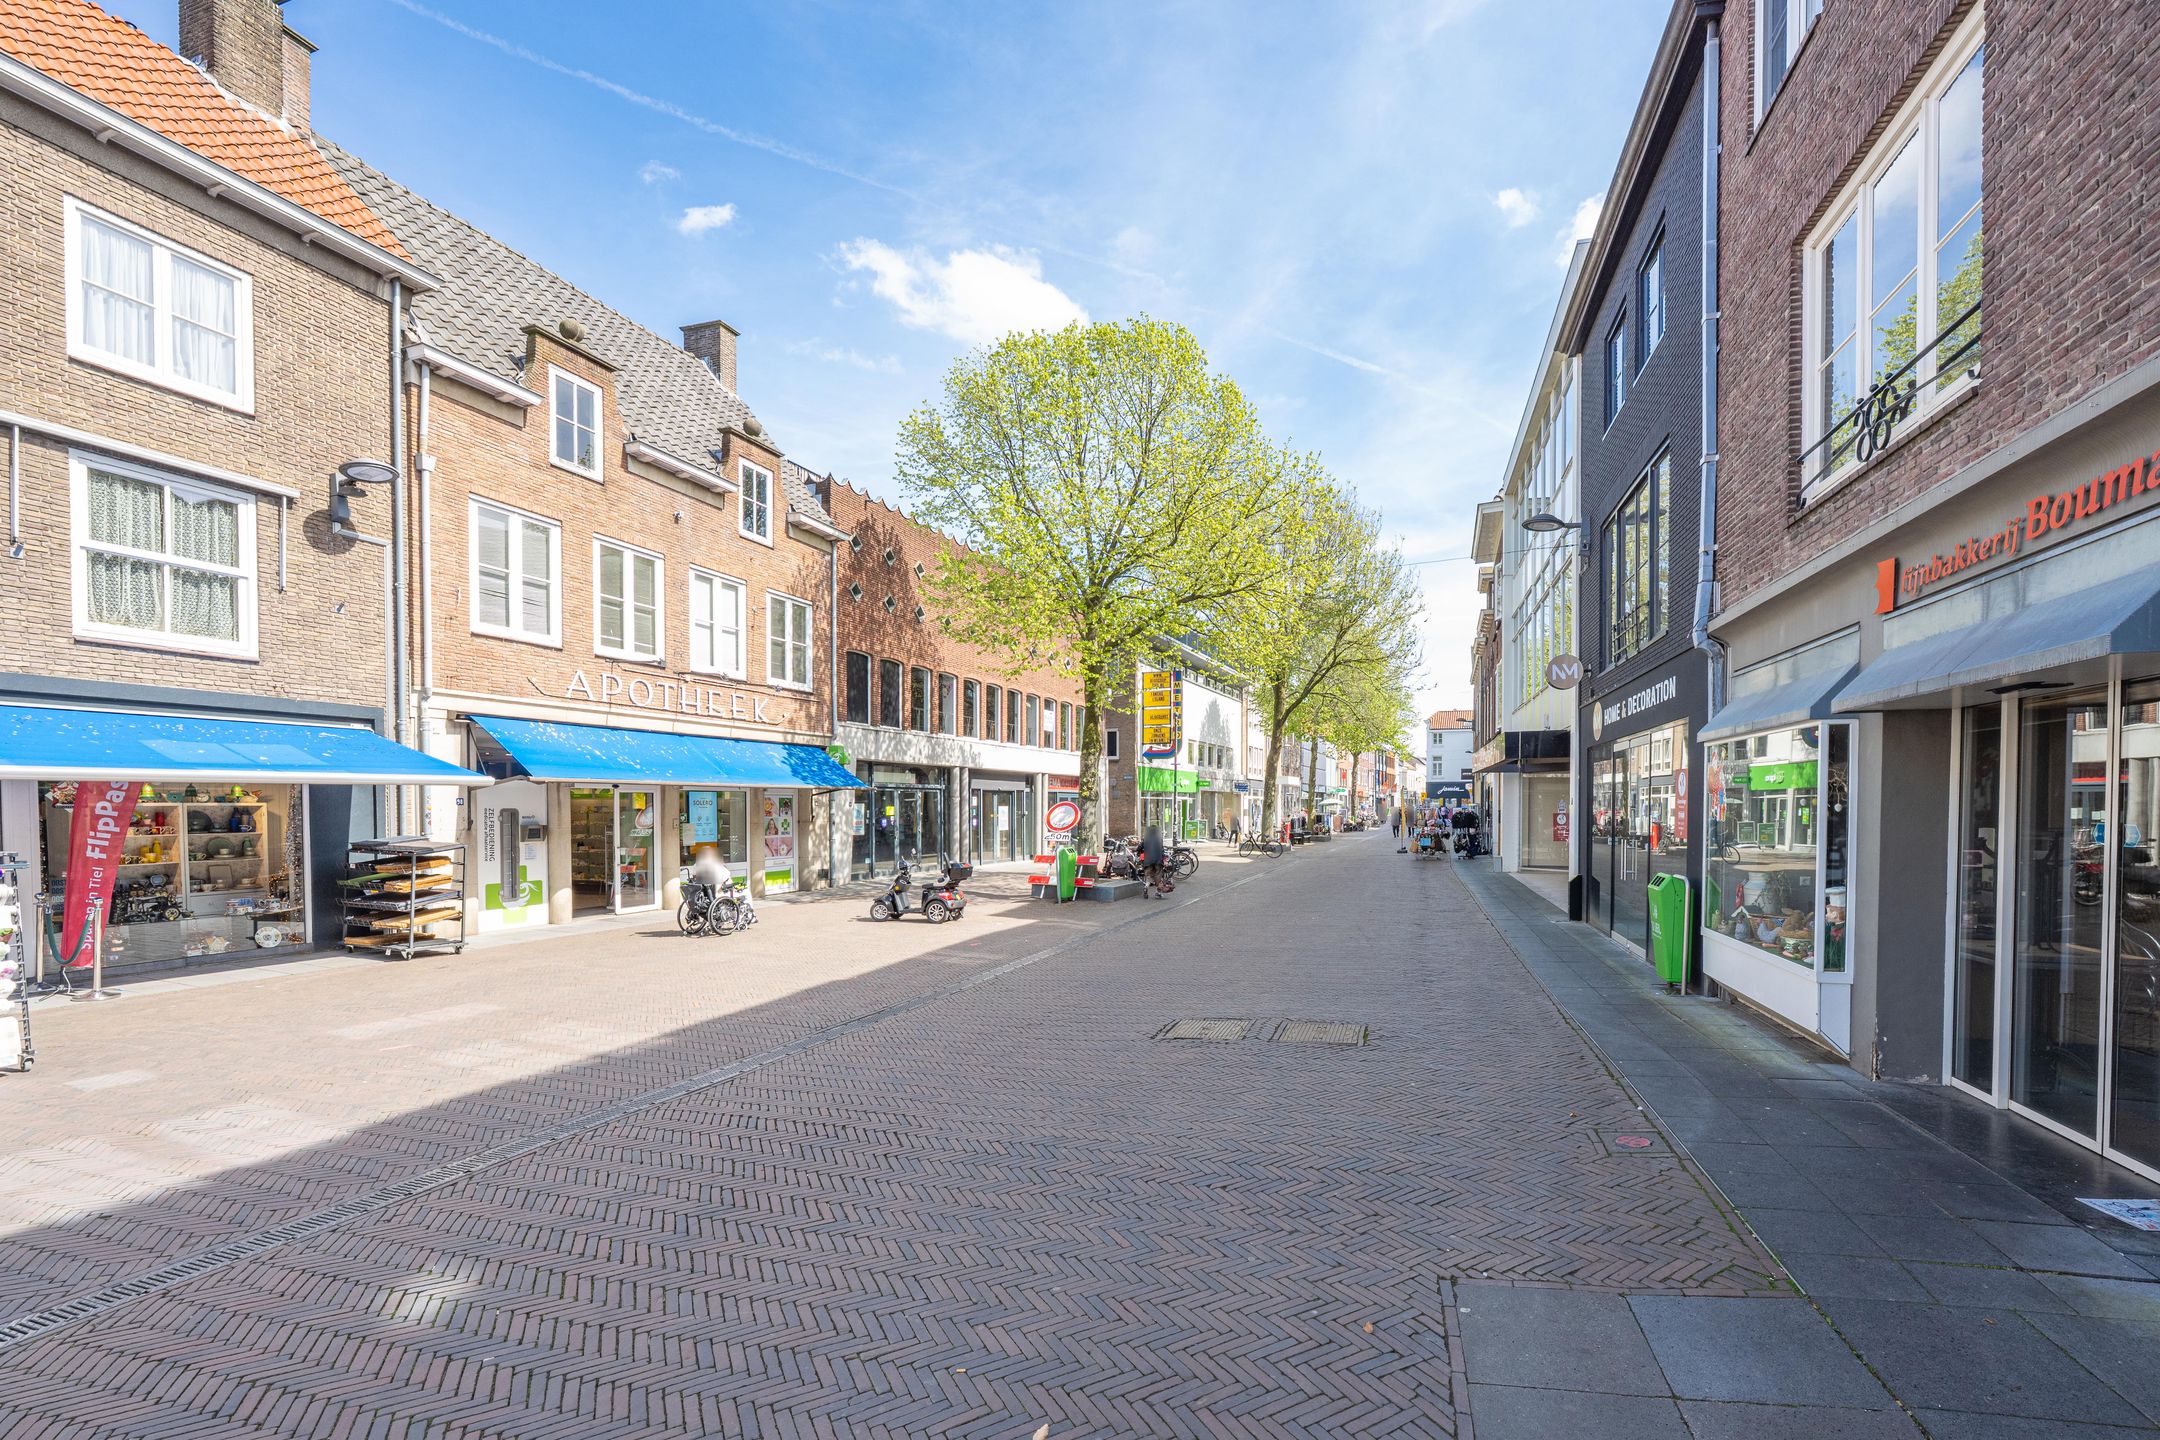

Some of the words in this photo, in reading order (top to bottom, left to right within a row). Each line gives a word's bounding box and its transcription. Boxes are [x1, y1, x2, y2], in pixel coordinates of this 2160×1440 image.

[566, 669, 770, 724] APOTHEEK
[1604, 703, 1620, 726] HOME
[1621, 701, 1627, 719] &
[1628, 676, 1676, 716] DECORATION
[88, 867, 104, 889] Tiel
